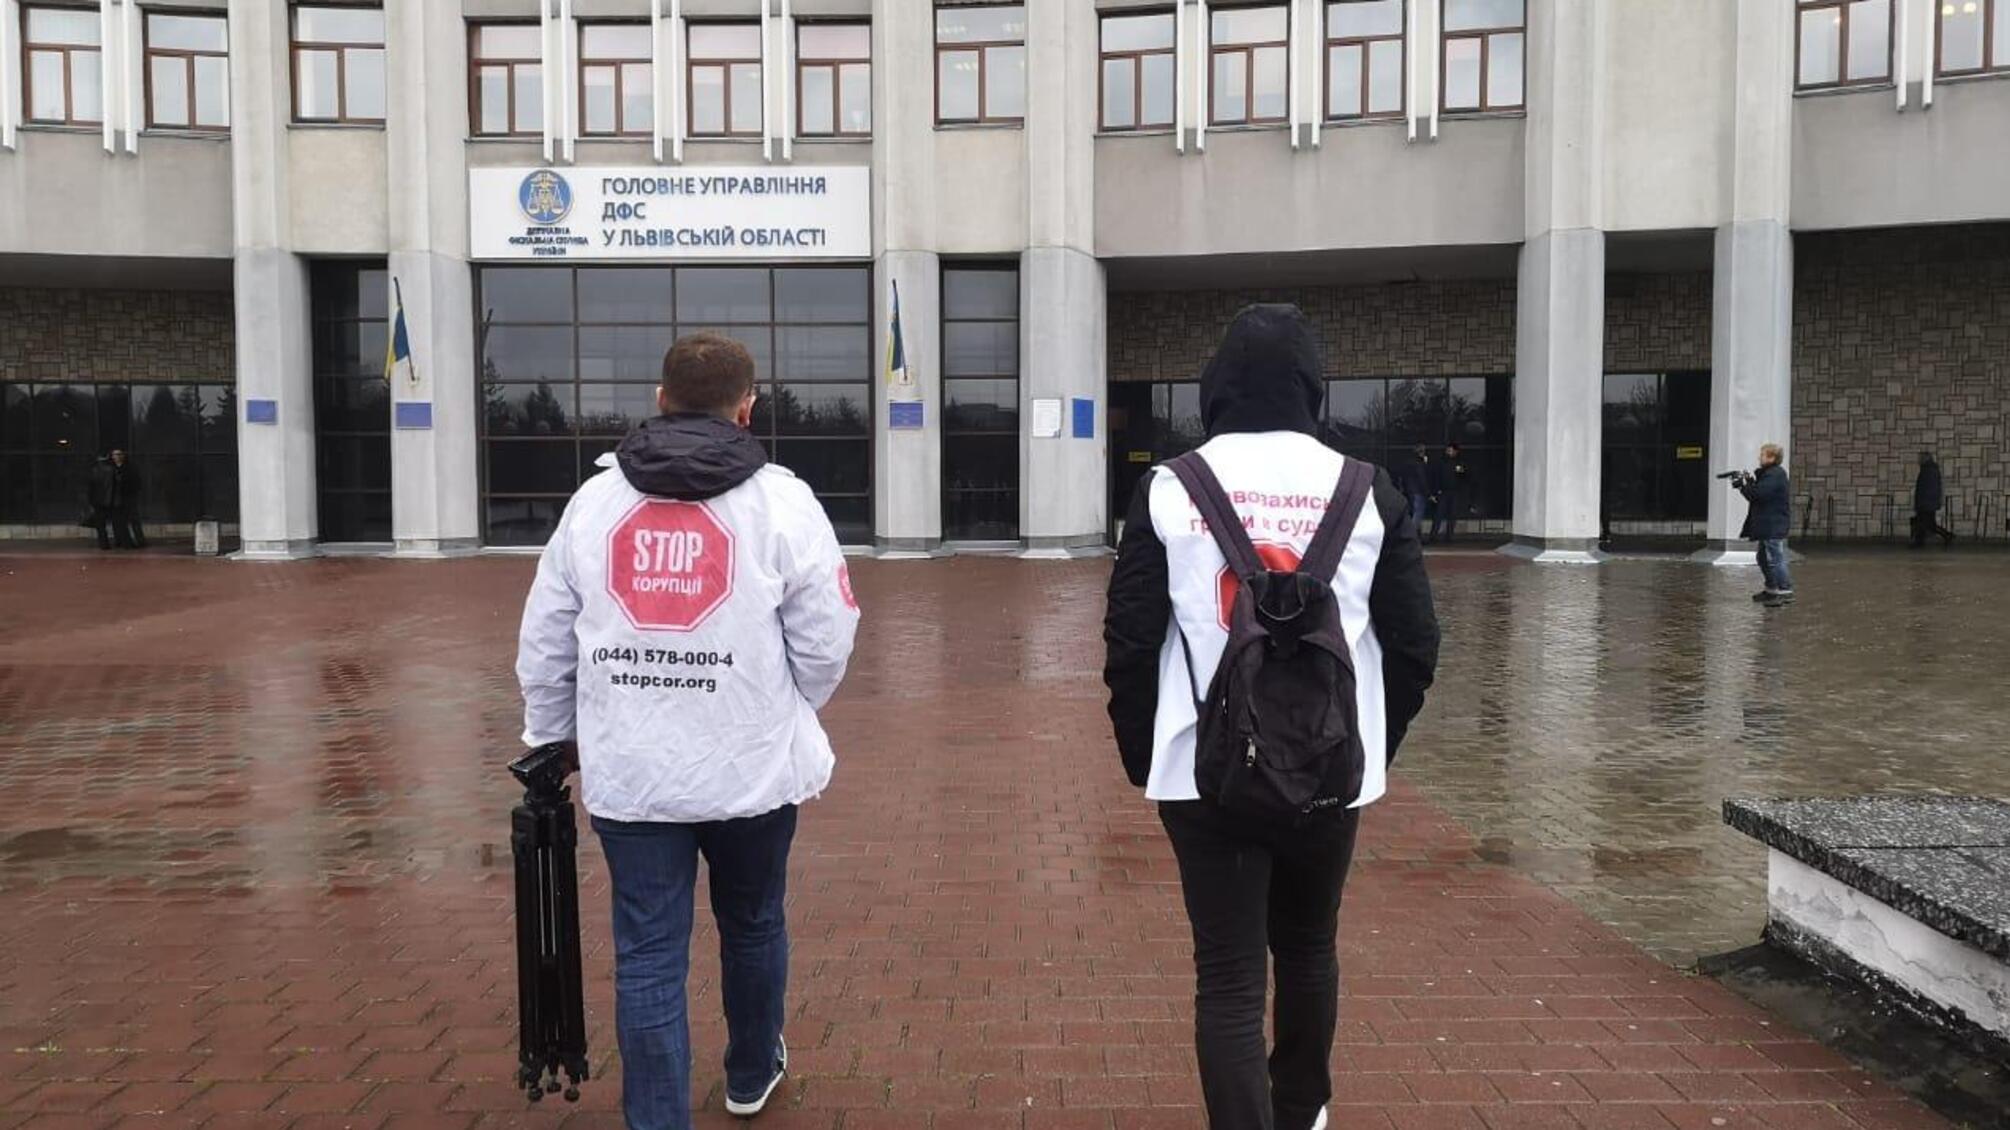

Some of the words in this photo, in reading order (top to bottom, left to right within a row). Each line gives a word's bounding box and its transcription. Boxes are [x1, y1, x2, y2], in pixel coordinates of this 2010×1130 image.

[602, 177, 697, 195] ГОЛОВНЕ
[700, 176, 827, 195] УПРАВЛІННЯ
[601, 201, 647, 222] ДФС
[602, 228, 616, 247] У
[619, 225, 735, 247] ЛЬВІВСЬКІЙ
[740, 227, 826, 247] ОБЛАСТІ
[632, 528, 704, 573] STOP
[592, 647, 639, 666] (044)
[644, 649, 734, 668] 578-000-4
[610, 672, 717, 693] stopcor.org
